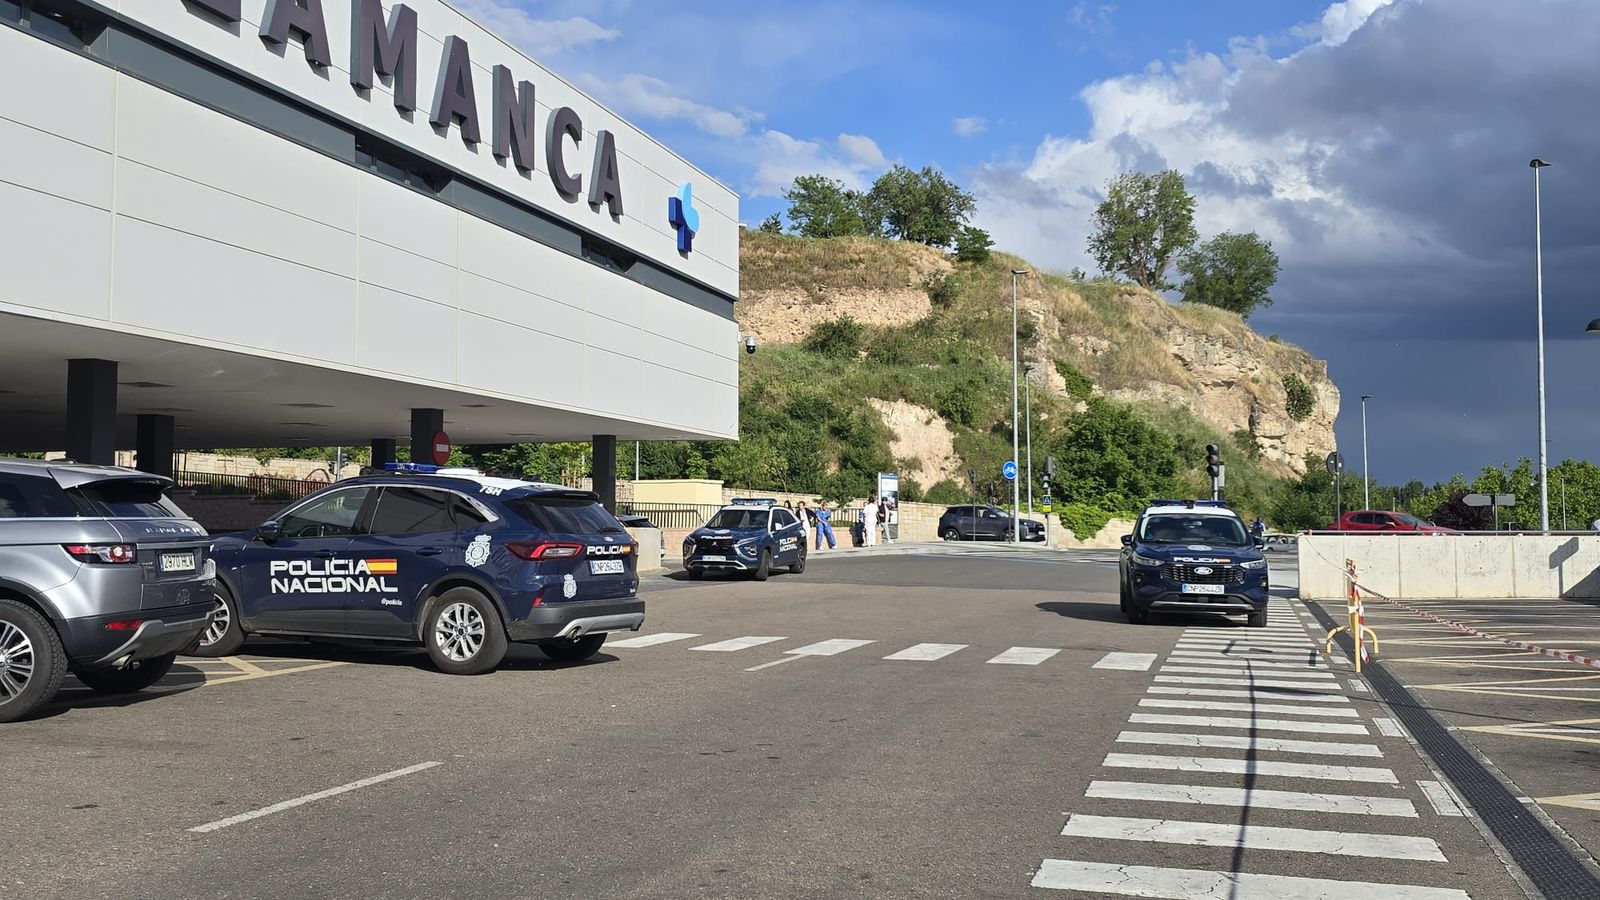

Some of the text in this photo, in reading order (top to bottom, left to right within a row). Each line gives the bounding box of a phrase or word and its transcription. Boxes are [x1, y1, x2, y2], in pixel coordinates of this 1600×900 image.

[181, 0, 624, 216] AMANCA
[587, 545, 624, 555] POLICIA
[270, 559, 371, 576] POLICIA
[270, 577, 398, 594] NACIONAL
